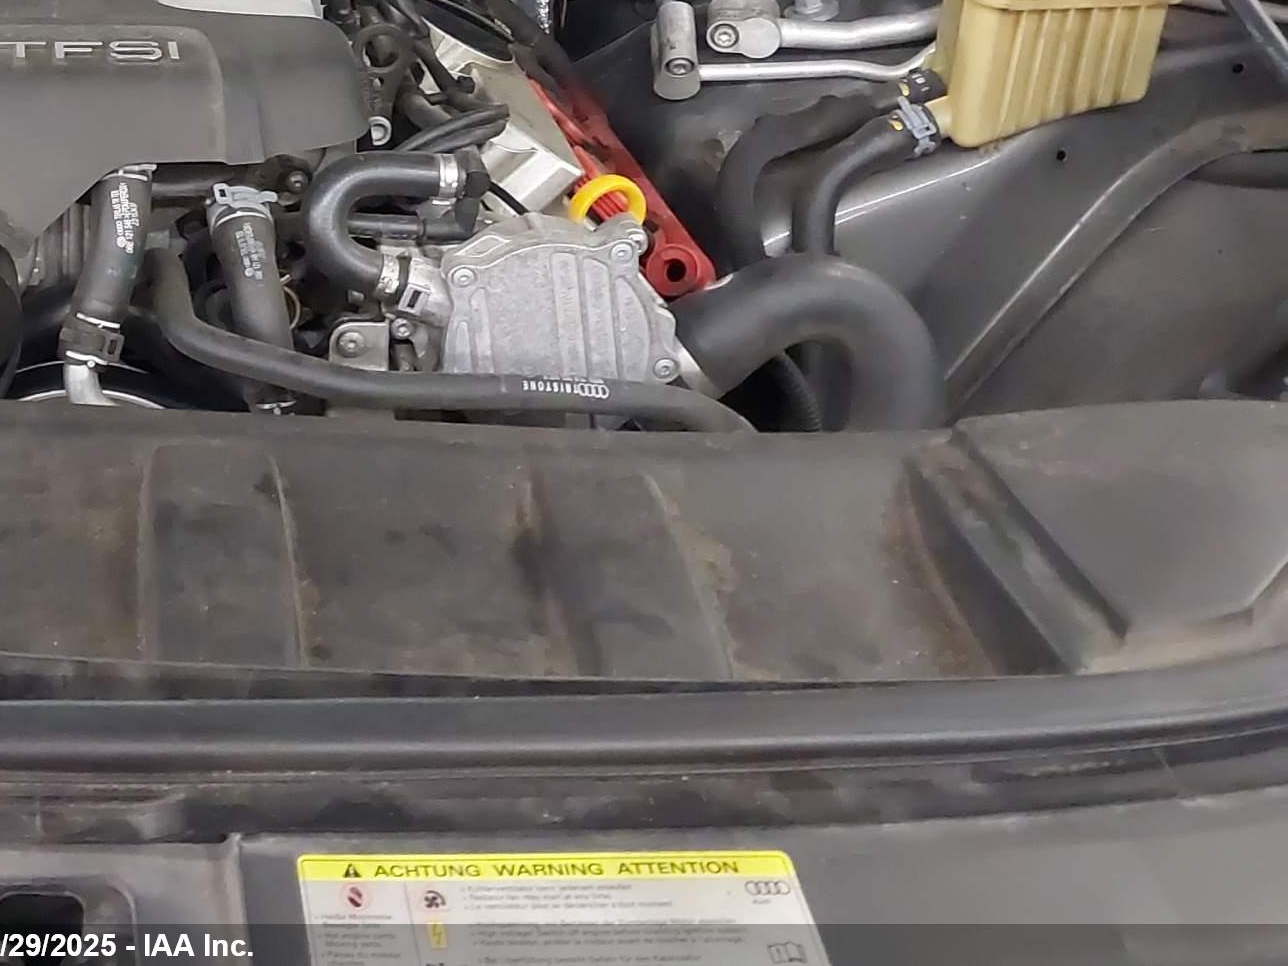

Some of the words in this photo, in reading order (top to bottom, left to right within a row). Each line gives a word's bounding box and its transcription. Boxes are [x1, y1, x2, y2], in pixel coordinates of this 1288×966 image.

[374, 864, 481, 878] ACHTUNG
[493, 862, 604, 877] WARNING
[618, 860, 739, 875] ATTENTION
